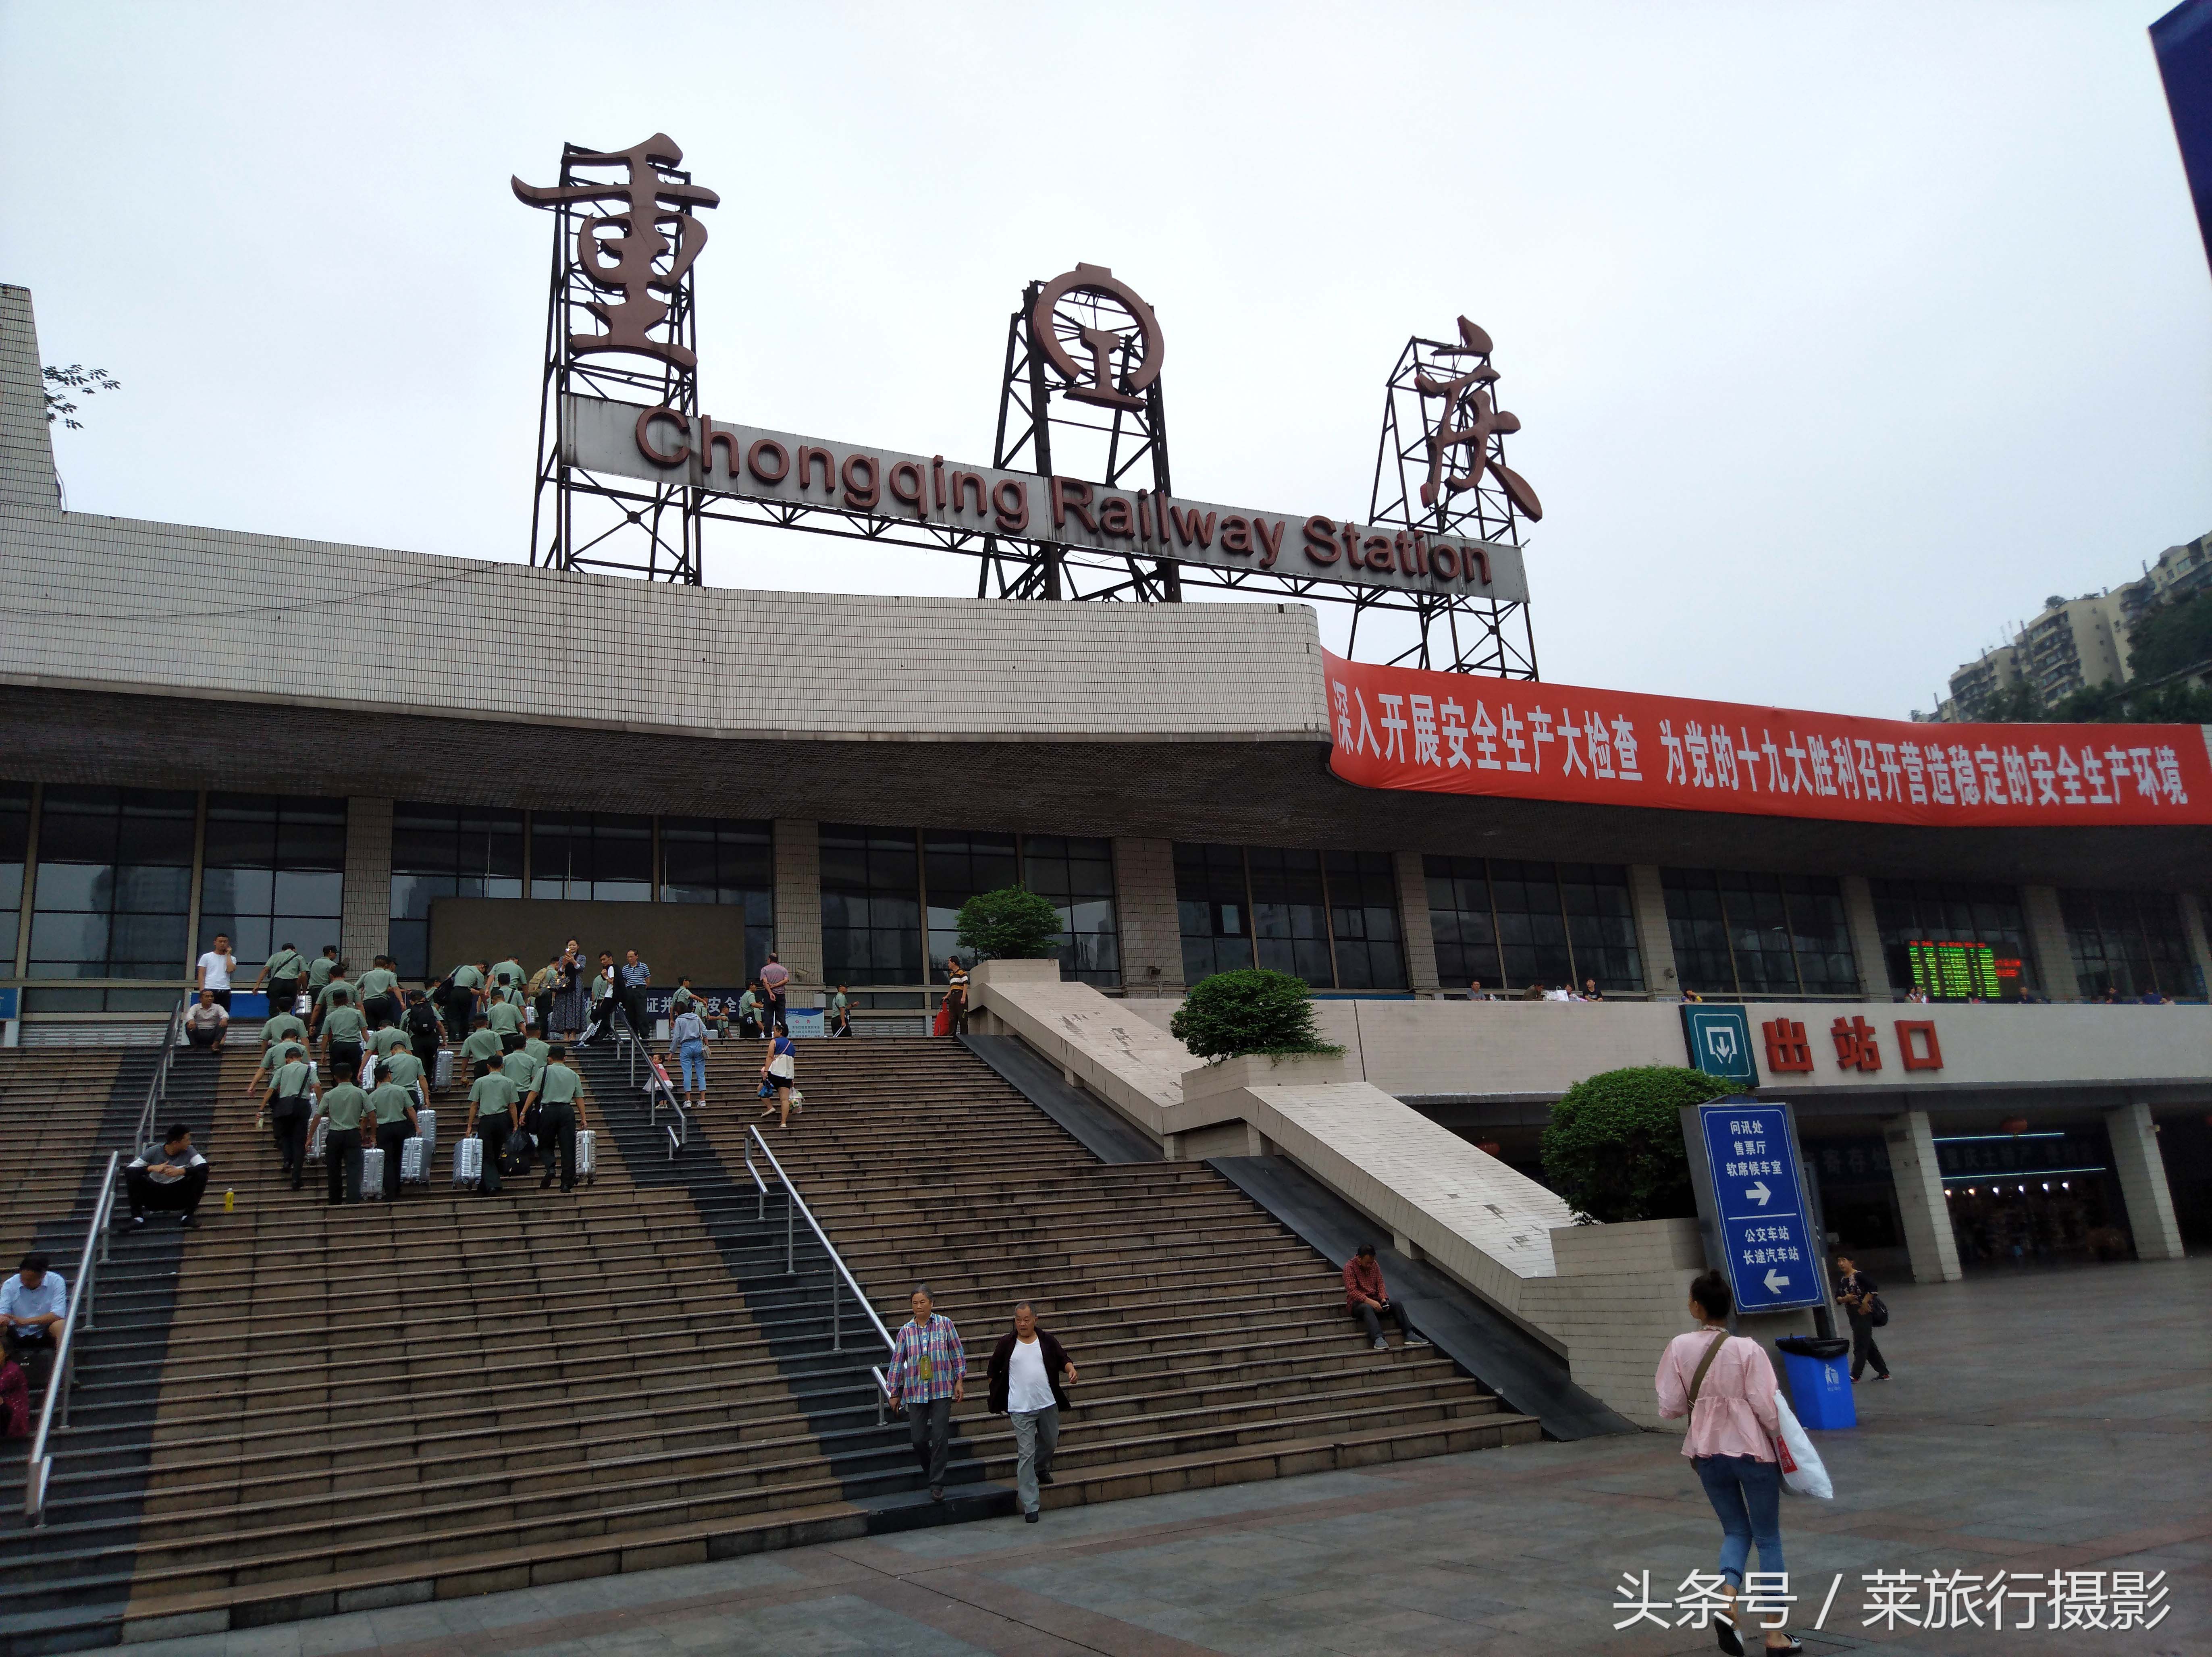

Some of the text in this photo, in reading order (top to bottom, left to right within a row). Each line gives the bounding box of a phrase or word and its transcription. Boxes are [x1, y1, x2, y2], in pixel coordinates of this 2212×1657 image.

[511, 133, 720, 374] 重
[636, 406, 1492, 585] Chongqing Railway Station
[1332, 677, 2189, 806] 深入开展安全生产大检查 为党的十九大胜利召开营造稳定的安全生产环境
[1762, 1015, 1944, 1073] 出站口
[1730, 1120, 1764, 1135] 问讯处
[1734, 1140, 1766, 1156] 售票厅
[1726, 1160, 1782, 1177] 软席候车室
[1745, 1226, 1790, 1243] 公交车站
[1743, 1246, 1799, 1265] 长途汽车站
